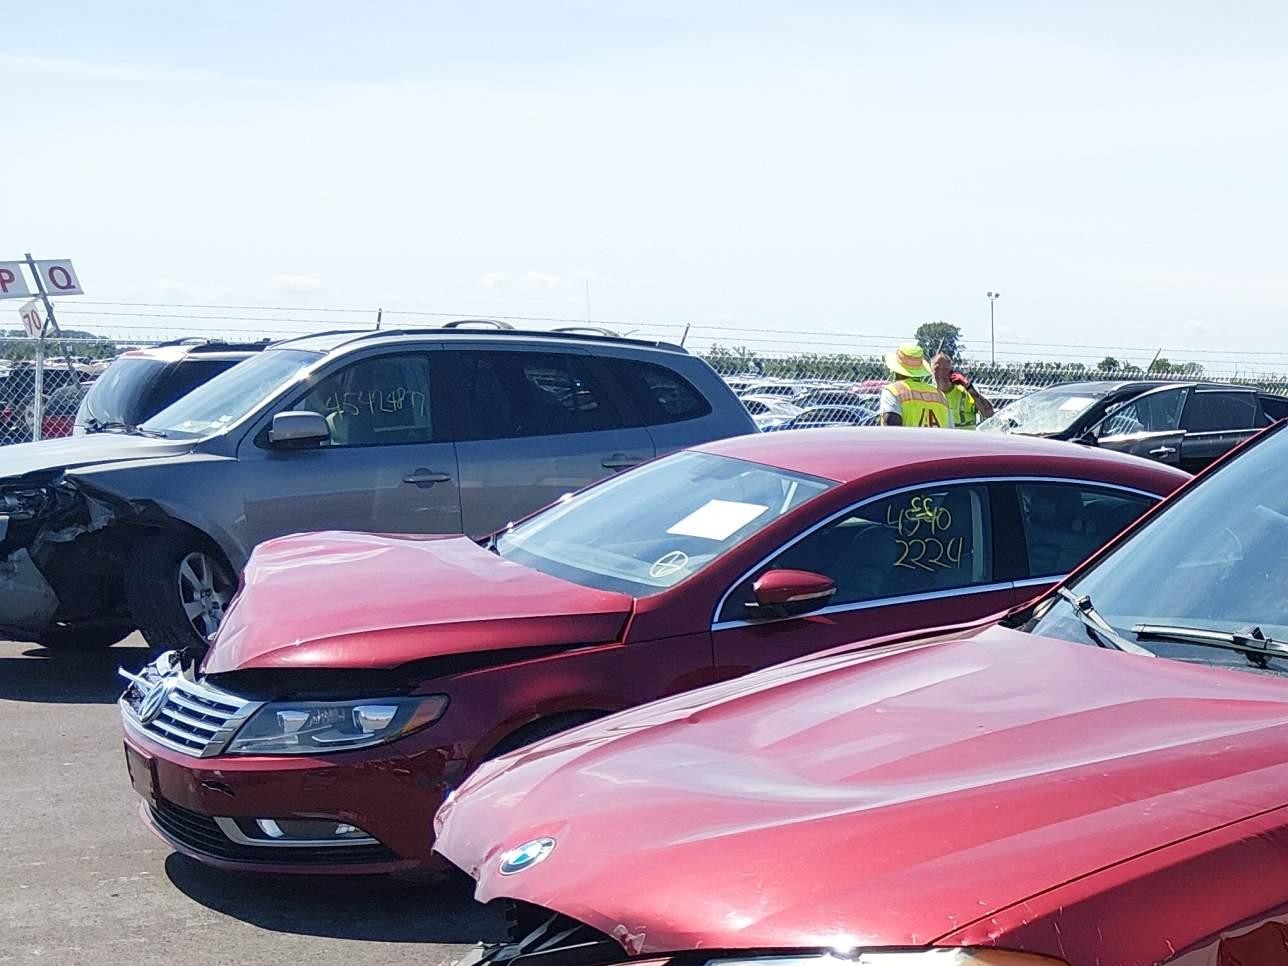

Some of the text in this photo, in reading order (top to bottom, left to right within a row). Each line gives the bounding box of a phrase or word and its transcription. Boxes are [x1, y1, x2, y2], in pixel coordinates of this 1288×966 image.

[0, 266, 76, 293] P Q
[893, 537, 963, 572] 2224
